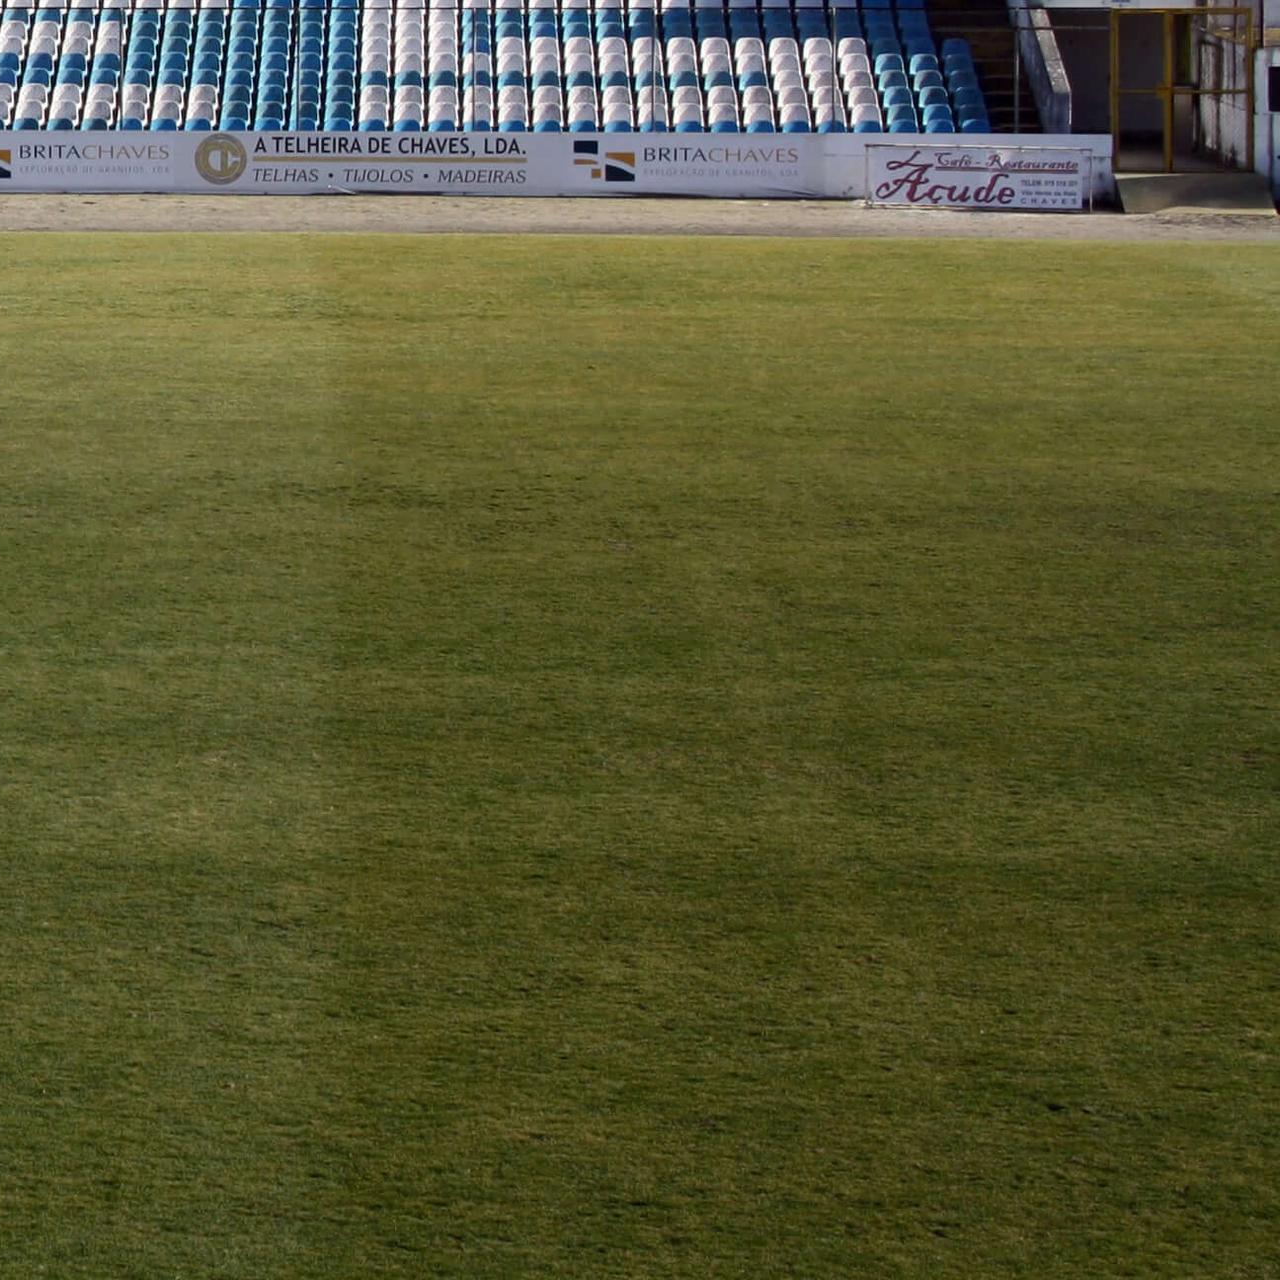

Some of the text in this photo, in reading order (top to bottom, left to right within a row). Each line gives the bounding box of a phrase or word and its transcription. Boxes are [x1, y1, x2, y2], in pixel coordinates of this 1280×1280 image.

[19, 144, 169, 160] BRITACHAVES
[254, 136, 527, 157] A TELHEIRA DE CHAVES, LDA.
[644, 147, 799, 163] BRITACHAVES
[986, 153, 1079, 170] Restaurante
[252, 168, 527, 184] TELHAS TIJOLOS MADEIRAS
[876, 161, 1016, 204] Açude
